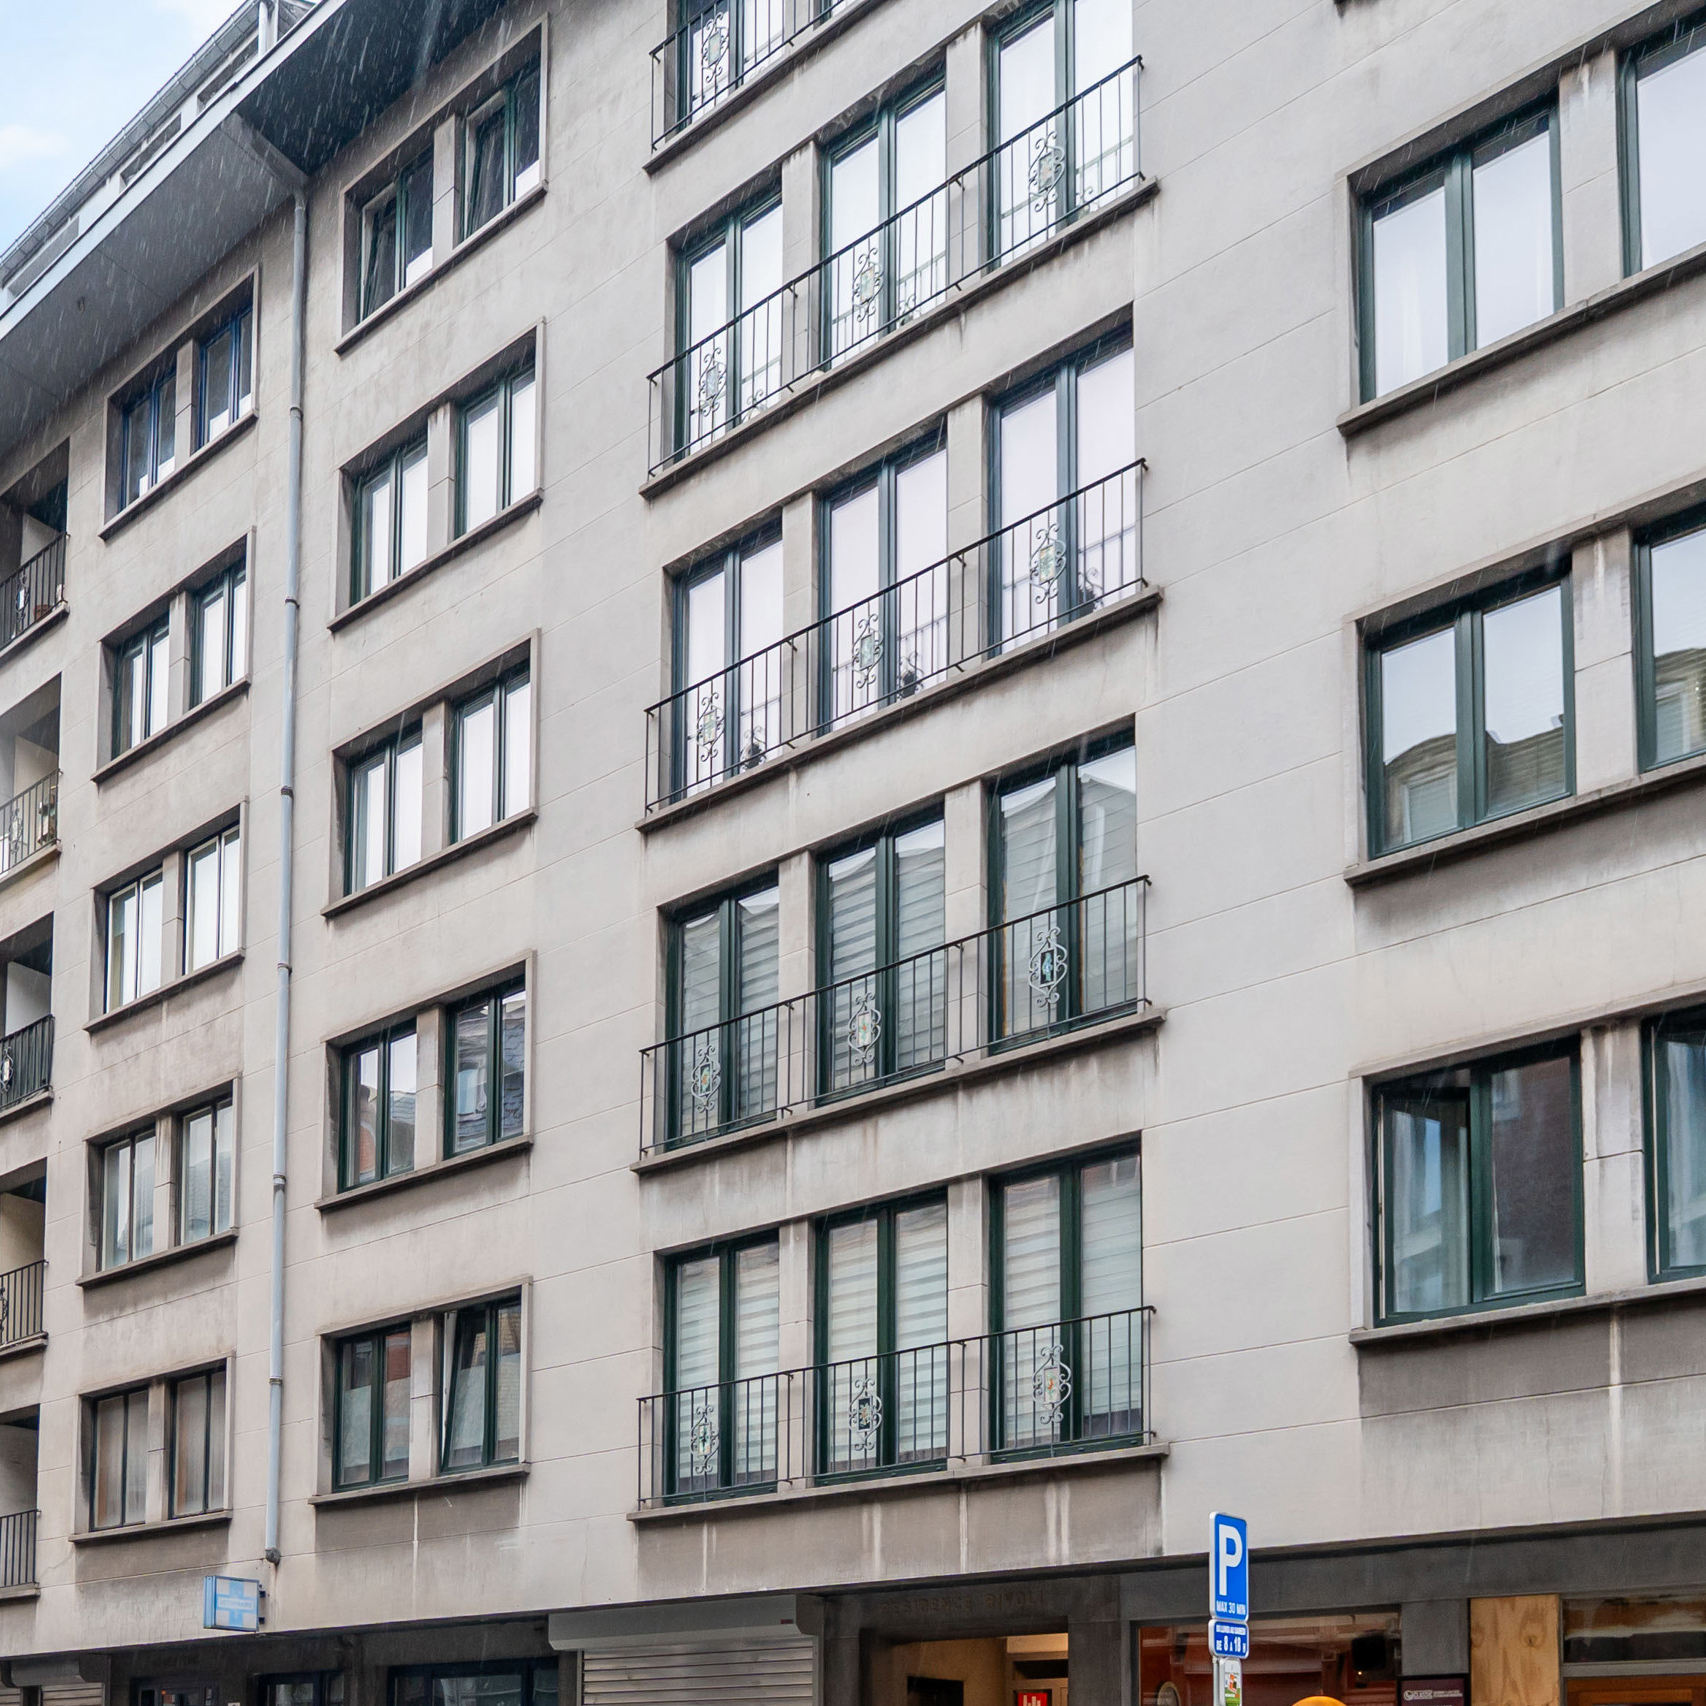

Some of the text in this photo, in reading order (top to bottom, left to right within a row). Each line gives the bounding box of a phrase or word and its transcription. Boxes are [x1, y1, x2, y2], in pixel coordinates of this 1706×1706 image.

[1219, 1523, 1243, 1596] P
[1216, 1600, 1246, 1615] MAX 30 MIN
[1224, 1635, 1229, 1652] 8
[1234, 1636, 1241, 1653] 18
